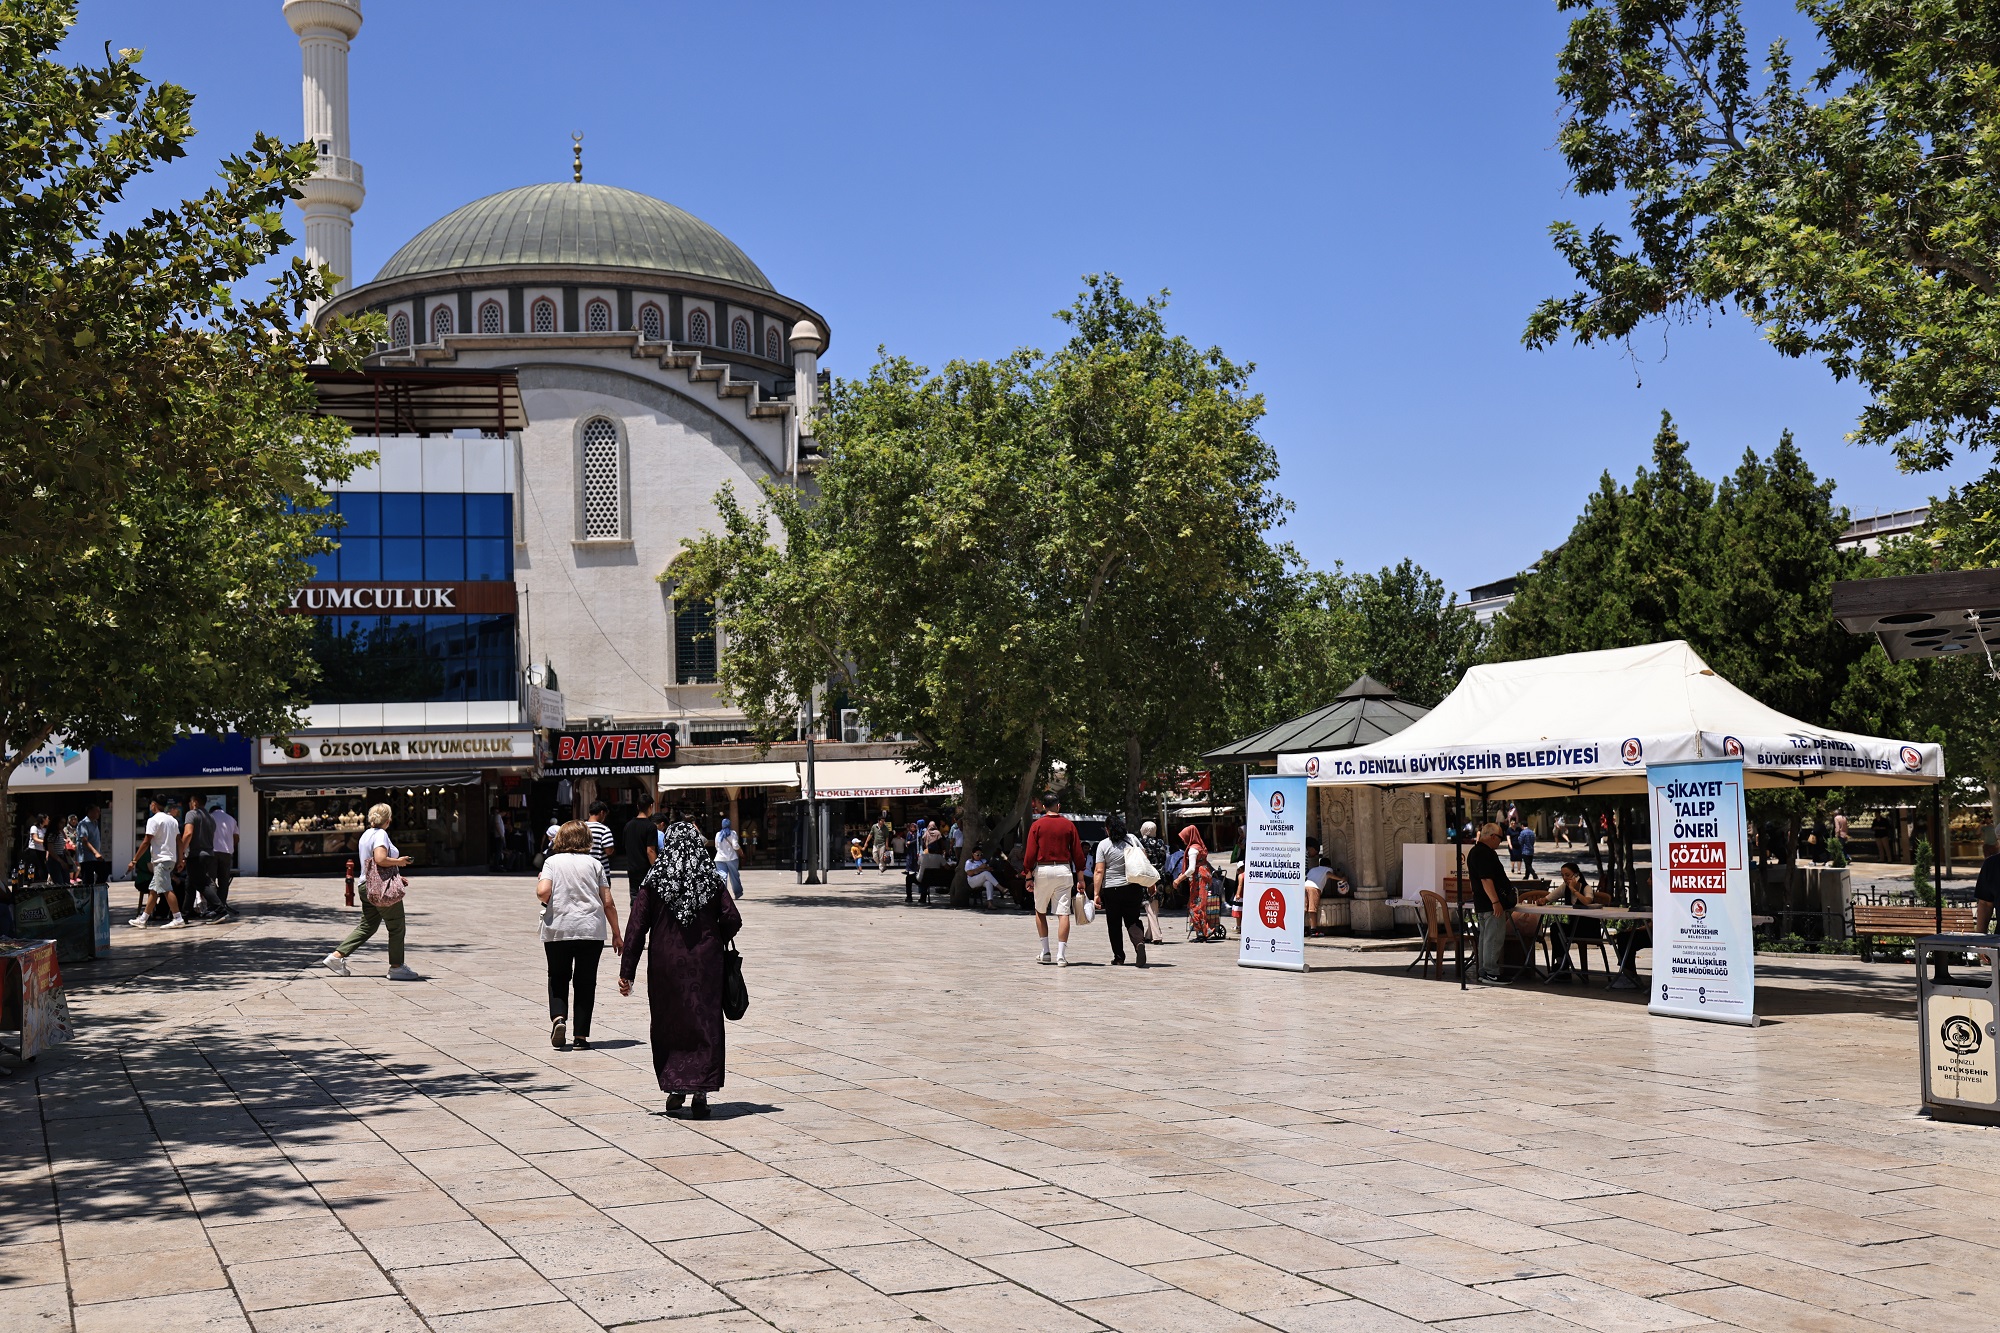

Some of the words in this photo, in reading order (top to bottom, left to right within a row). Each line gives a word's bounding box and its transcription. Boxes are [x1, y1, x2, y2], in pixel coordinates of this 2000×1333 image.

[288, 588, 455, 609] YUMCULUK
[320, 739, 400, 757] ÖZSOYLAR
[407, 738, 513, 754] KUYUMCULUK
[557, 733, 672, 761] BAYTEKS
[1790, 739, 1811, 749] T.C.
[1335, 761, 1355, 775] T.C.
[1360, 754, 1406, 774] DENİZLİ
[1410, 749, 1501, 775] BÜYÜKŞEHİR
[1505, 743, 1599, 769] BELEDİYESİ
[1757, 752, 1827, 768] BÜYÜKŞEHİR
[1830, 755, 1892, 770] BELEDİYESİ
[543, 767, 567, 777] MALAT
[569, 767, 598, 776] TOPTAN
[599, 766, 610, 775] VE
[611, 765, 655, 775] PERAKENDE
[827, 790, 851, 798] OKUL
[1667, 779, 1722, 803] ŞİKAYET
[1675, 801, 1715, 817] TALEP
[1674, 818, 1718, 838] ÖNERİ
[1671, 844, 1725, 867] ÇÖZÜM
[1249, 860, 1272, 868] HALKLA
[1273, 859, 1300, 870] İLİŞKİLER
[1248, 870, 1263, 879] ŞUBE
[1264, 869, 1301, 880] MÜDÜRLÜĞÜ
[1671, 871, 1725, 889] MERKEZİ
[1672, 957, 1697, 965] HALKLA
[1698, 956, 1727, 967] İLİŞKİLER
[1672, 966, 1688, 974] ŞUBE
[1689, 966, 1728, 976] MÜDÜRLÜĞÜ
[1938, 1065, 1988, 1076] BÜYÜKŞEHİR
